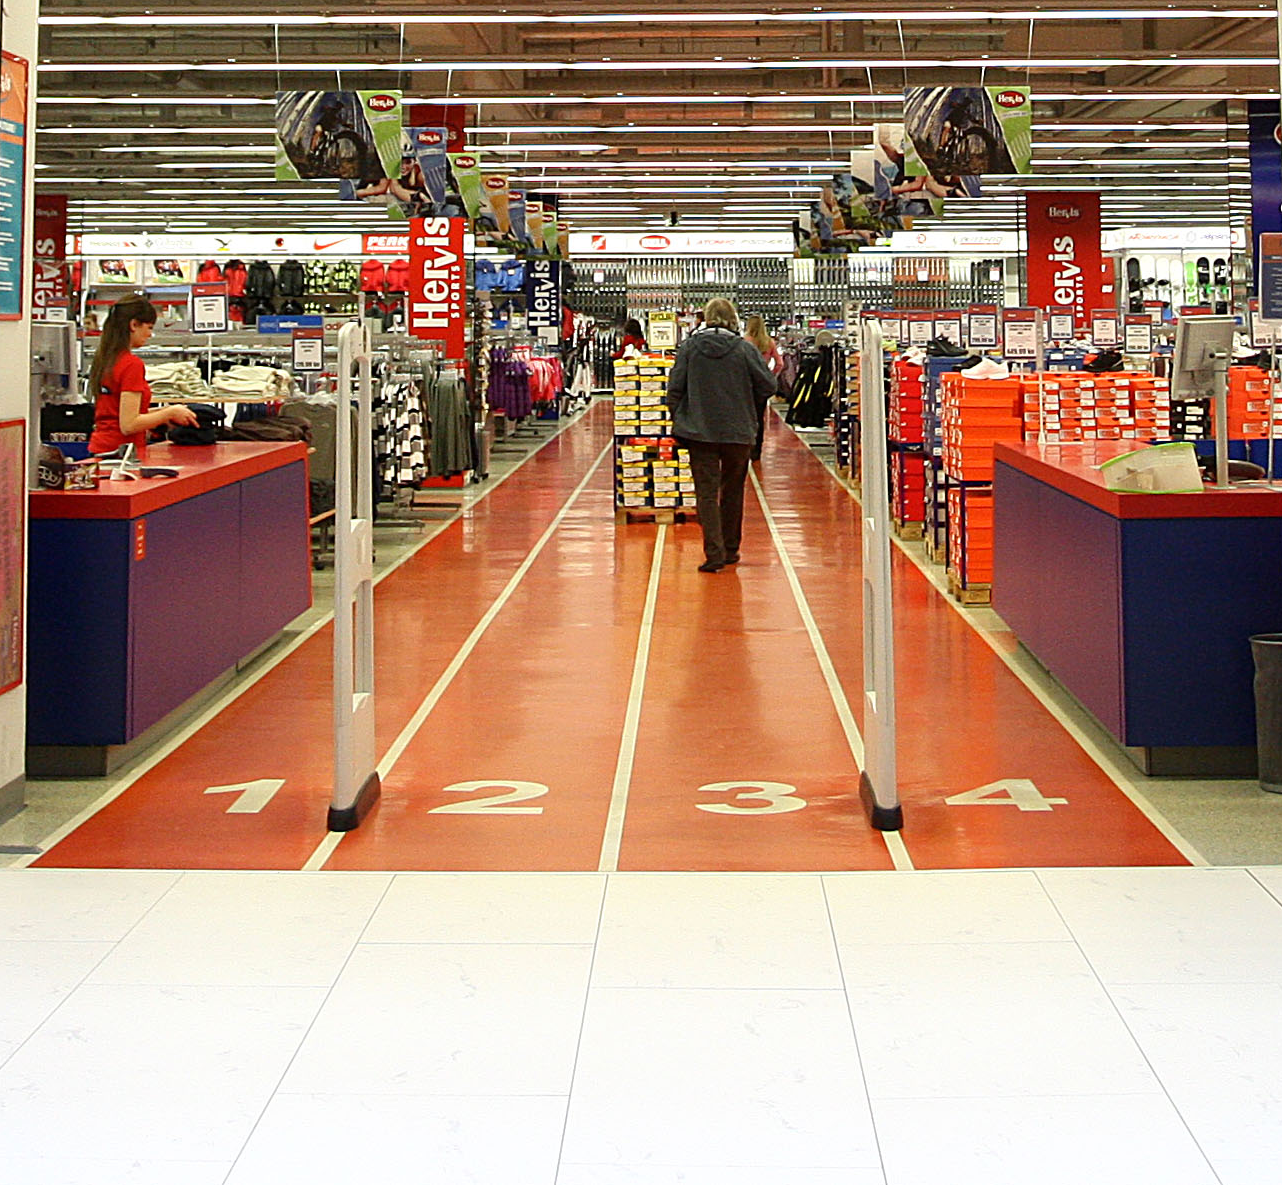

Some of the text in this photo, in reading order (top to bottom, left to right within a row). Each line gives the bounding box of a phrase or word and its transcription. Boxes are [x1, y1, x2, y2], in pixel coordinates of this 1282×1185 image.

[368, 235, 408, 248] PEAK
[413, 217, 458, 328] Hervis
[1048, 235, 1082, 307] ervis
[201, 778, 287, 813] 1
[426, 780, 550, 815] 2
[695, 781, 809, 816] 3
[943, 778, 1069, 812] 4
